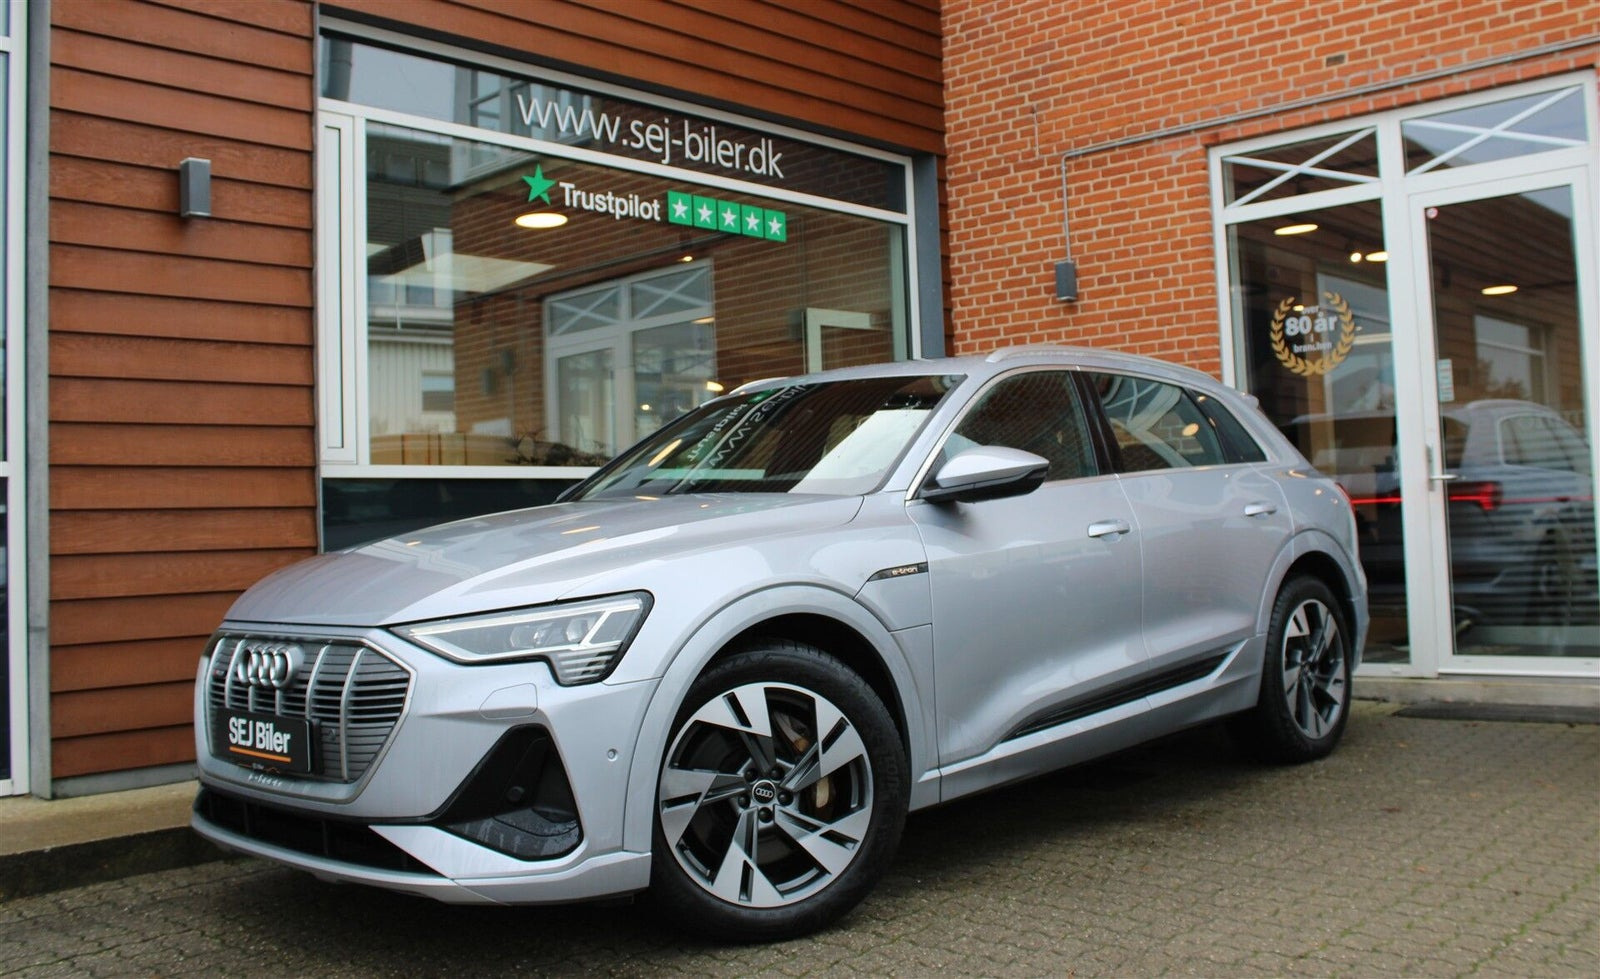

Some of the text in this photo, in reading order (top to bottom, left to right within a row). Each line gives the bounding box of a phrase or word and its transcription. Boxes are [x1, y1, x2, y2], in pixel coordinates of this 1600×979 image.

[517, 94, 784, 179] www.sej-biler.dk
[559, 181, 661, 222] Trustpilot
[1285, 311, 1338, 336] 80 år
[891, 566, 918, 576] e-tron
[229, 716, 291, 754] SEJ Biler
